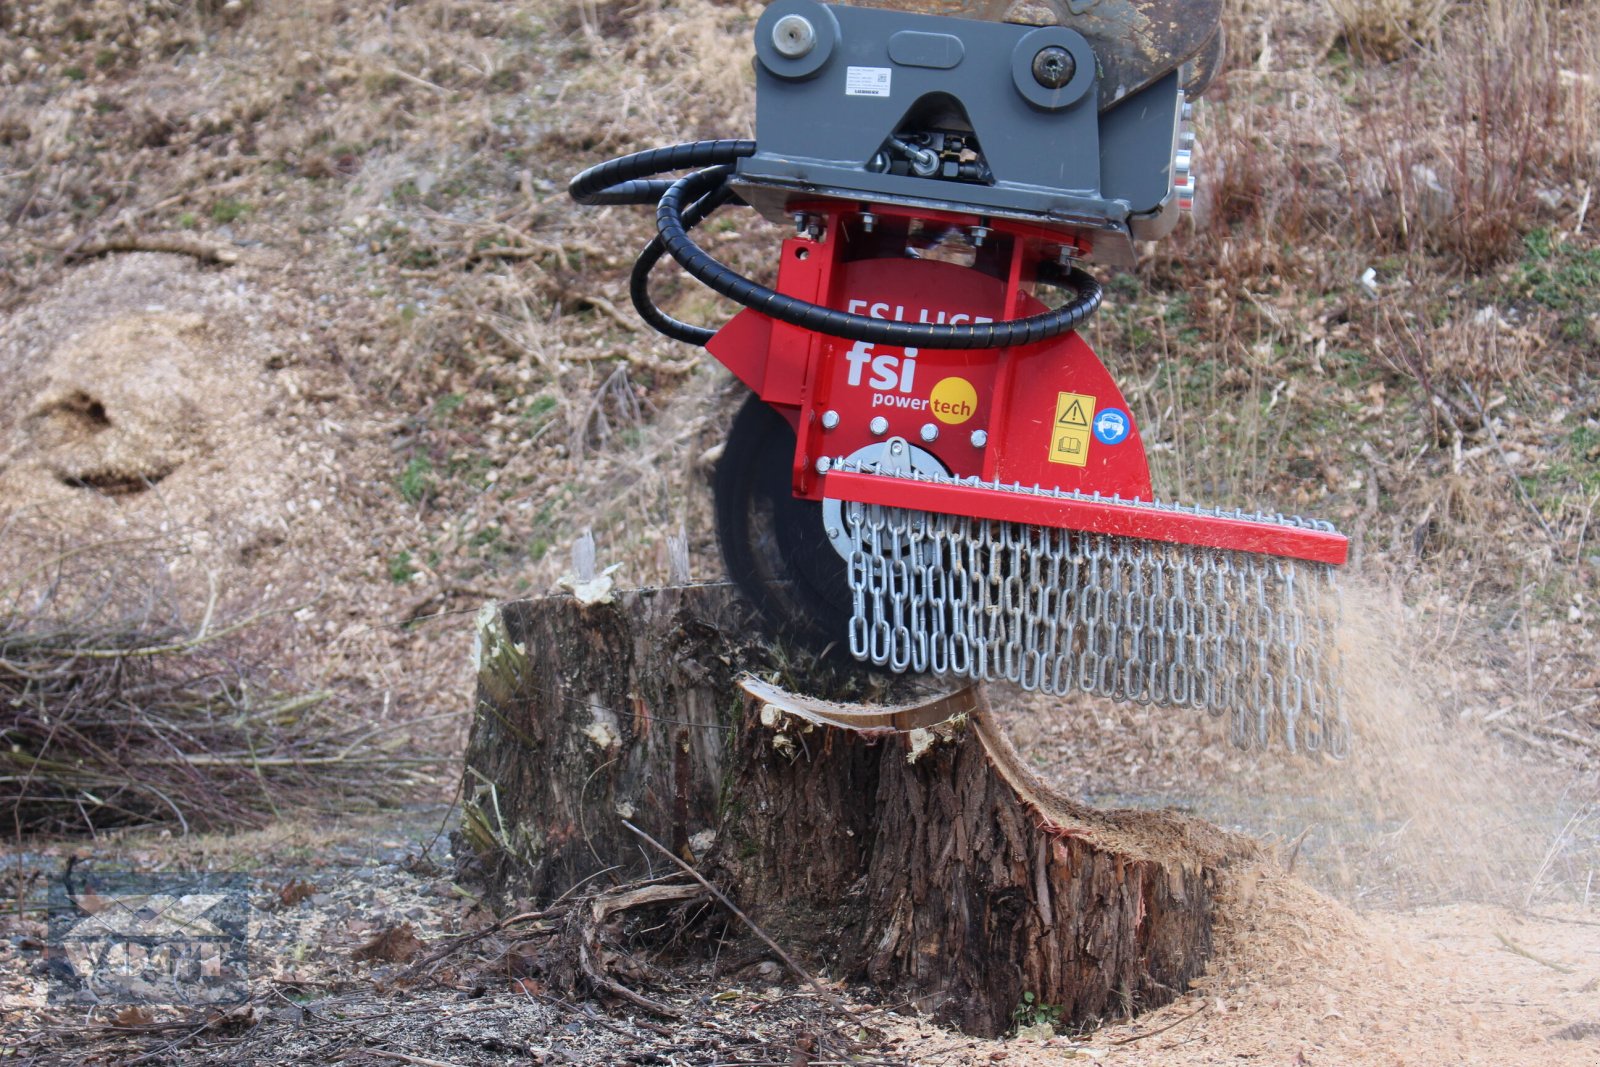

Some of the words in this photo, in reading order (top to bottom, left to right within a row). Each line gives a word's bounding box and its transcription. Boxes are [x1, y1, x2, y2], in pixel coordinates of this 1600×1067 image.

[845, 340, 919, 394] fsi
[872, 392, 930, 411] power
[933, 398, 971, 417] tech
